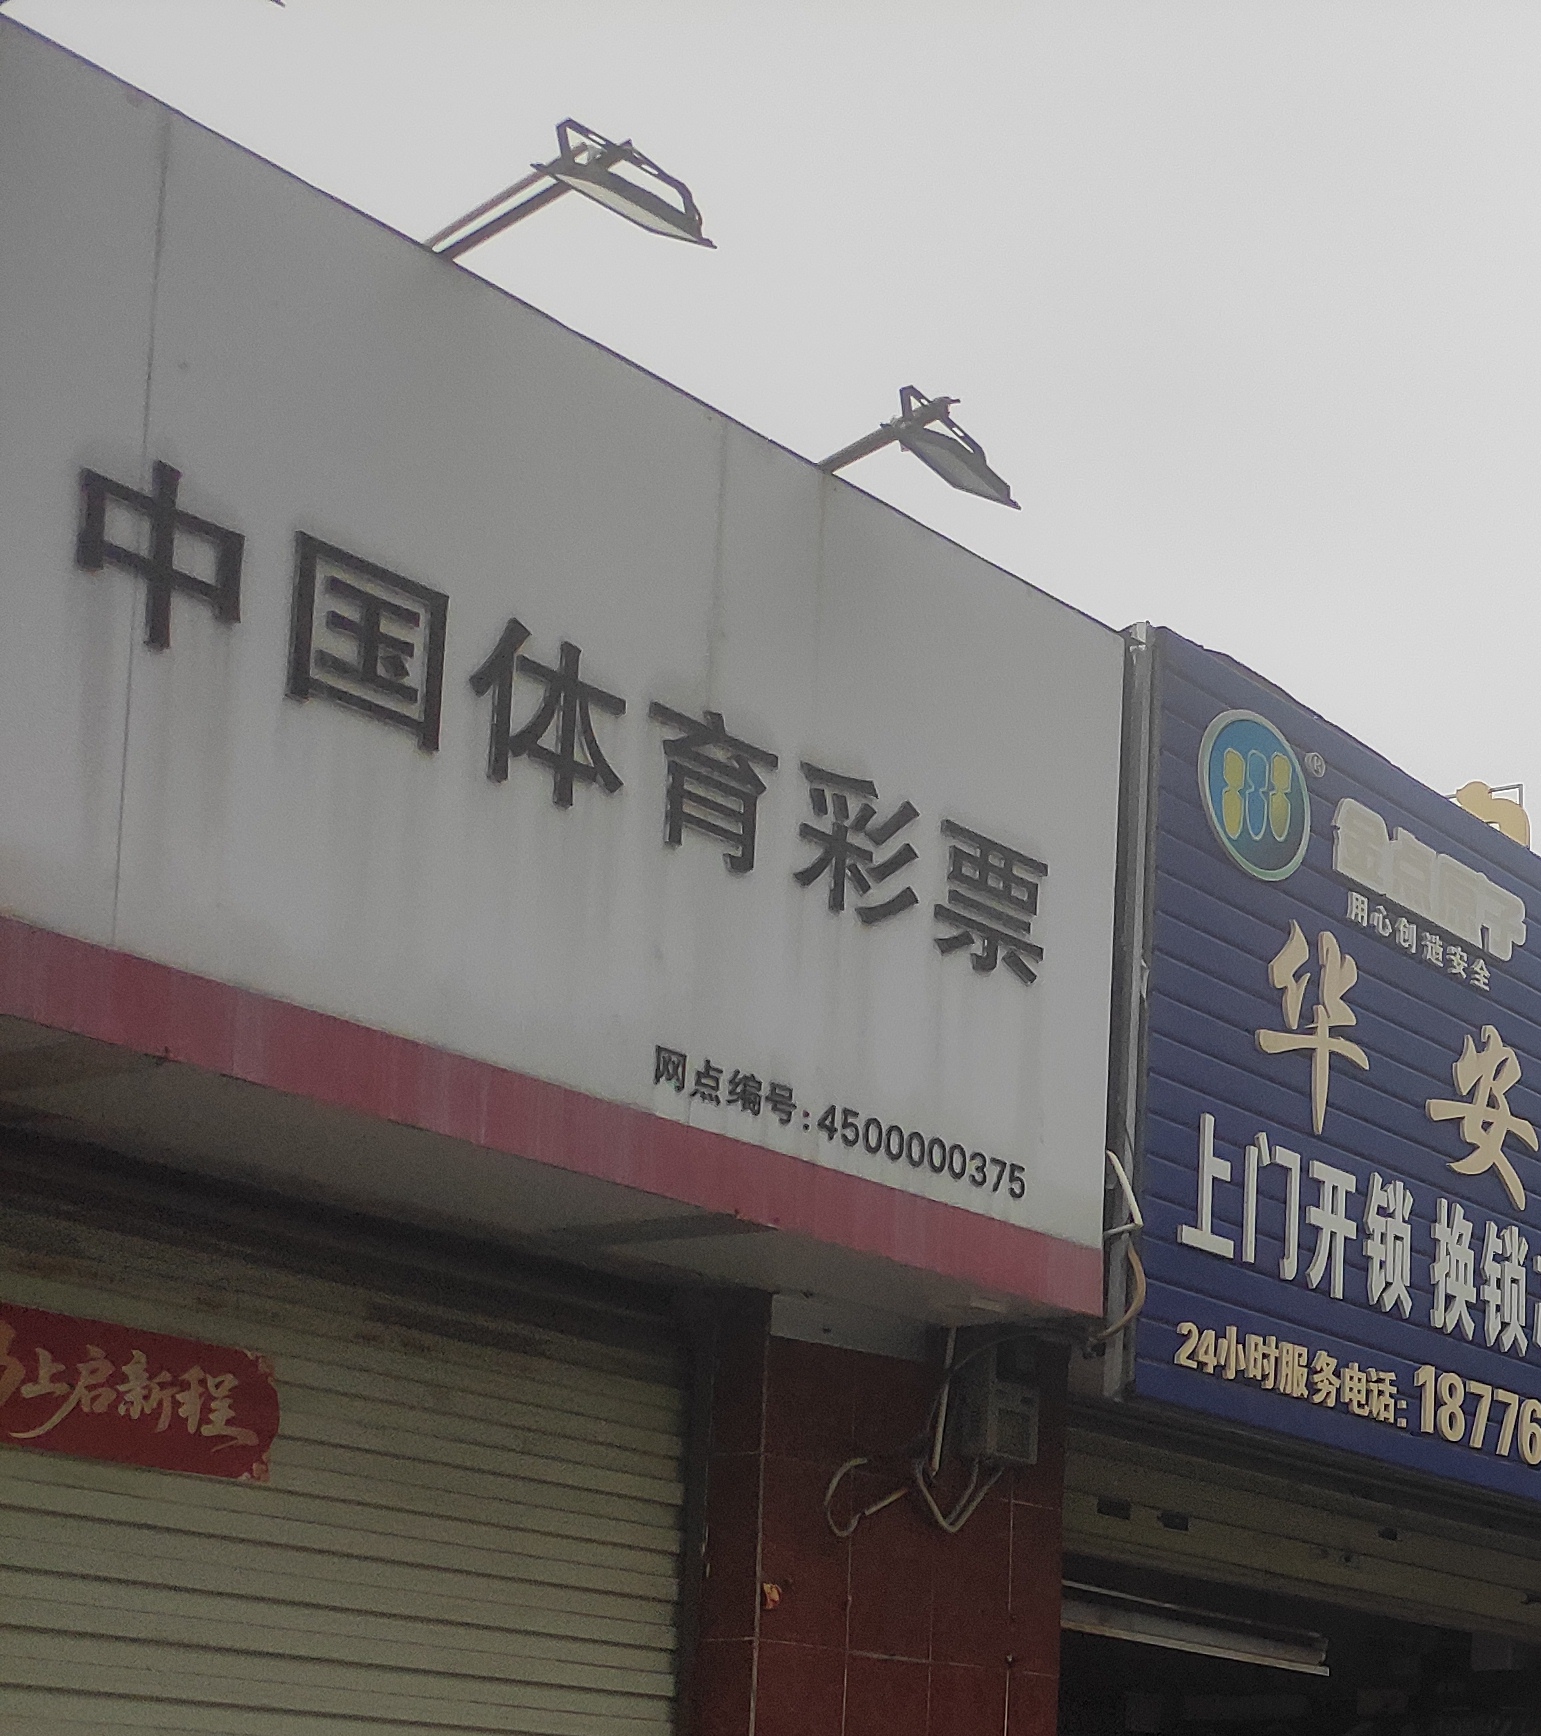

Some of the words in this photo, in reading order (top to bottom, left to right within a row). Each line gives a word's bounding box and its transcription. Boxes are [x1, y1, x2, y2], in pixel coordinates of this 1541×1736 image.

[75, 460, 1049, 986] 中国体育彩票
[1177, 1113, 1414, 1318] 上门开锁
